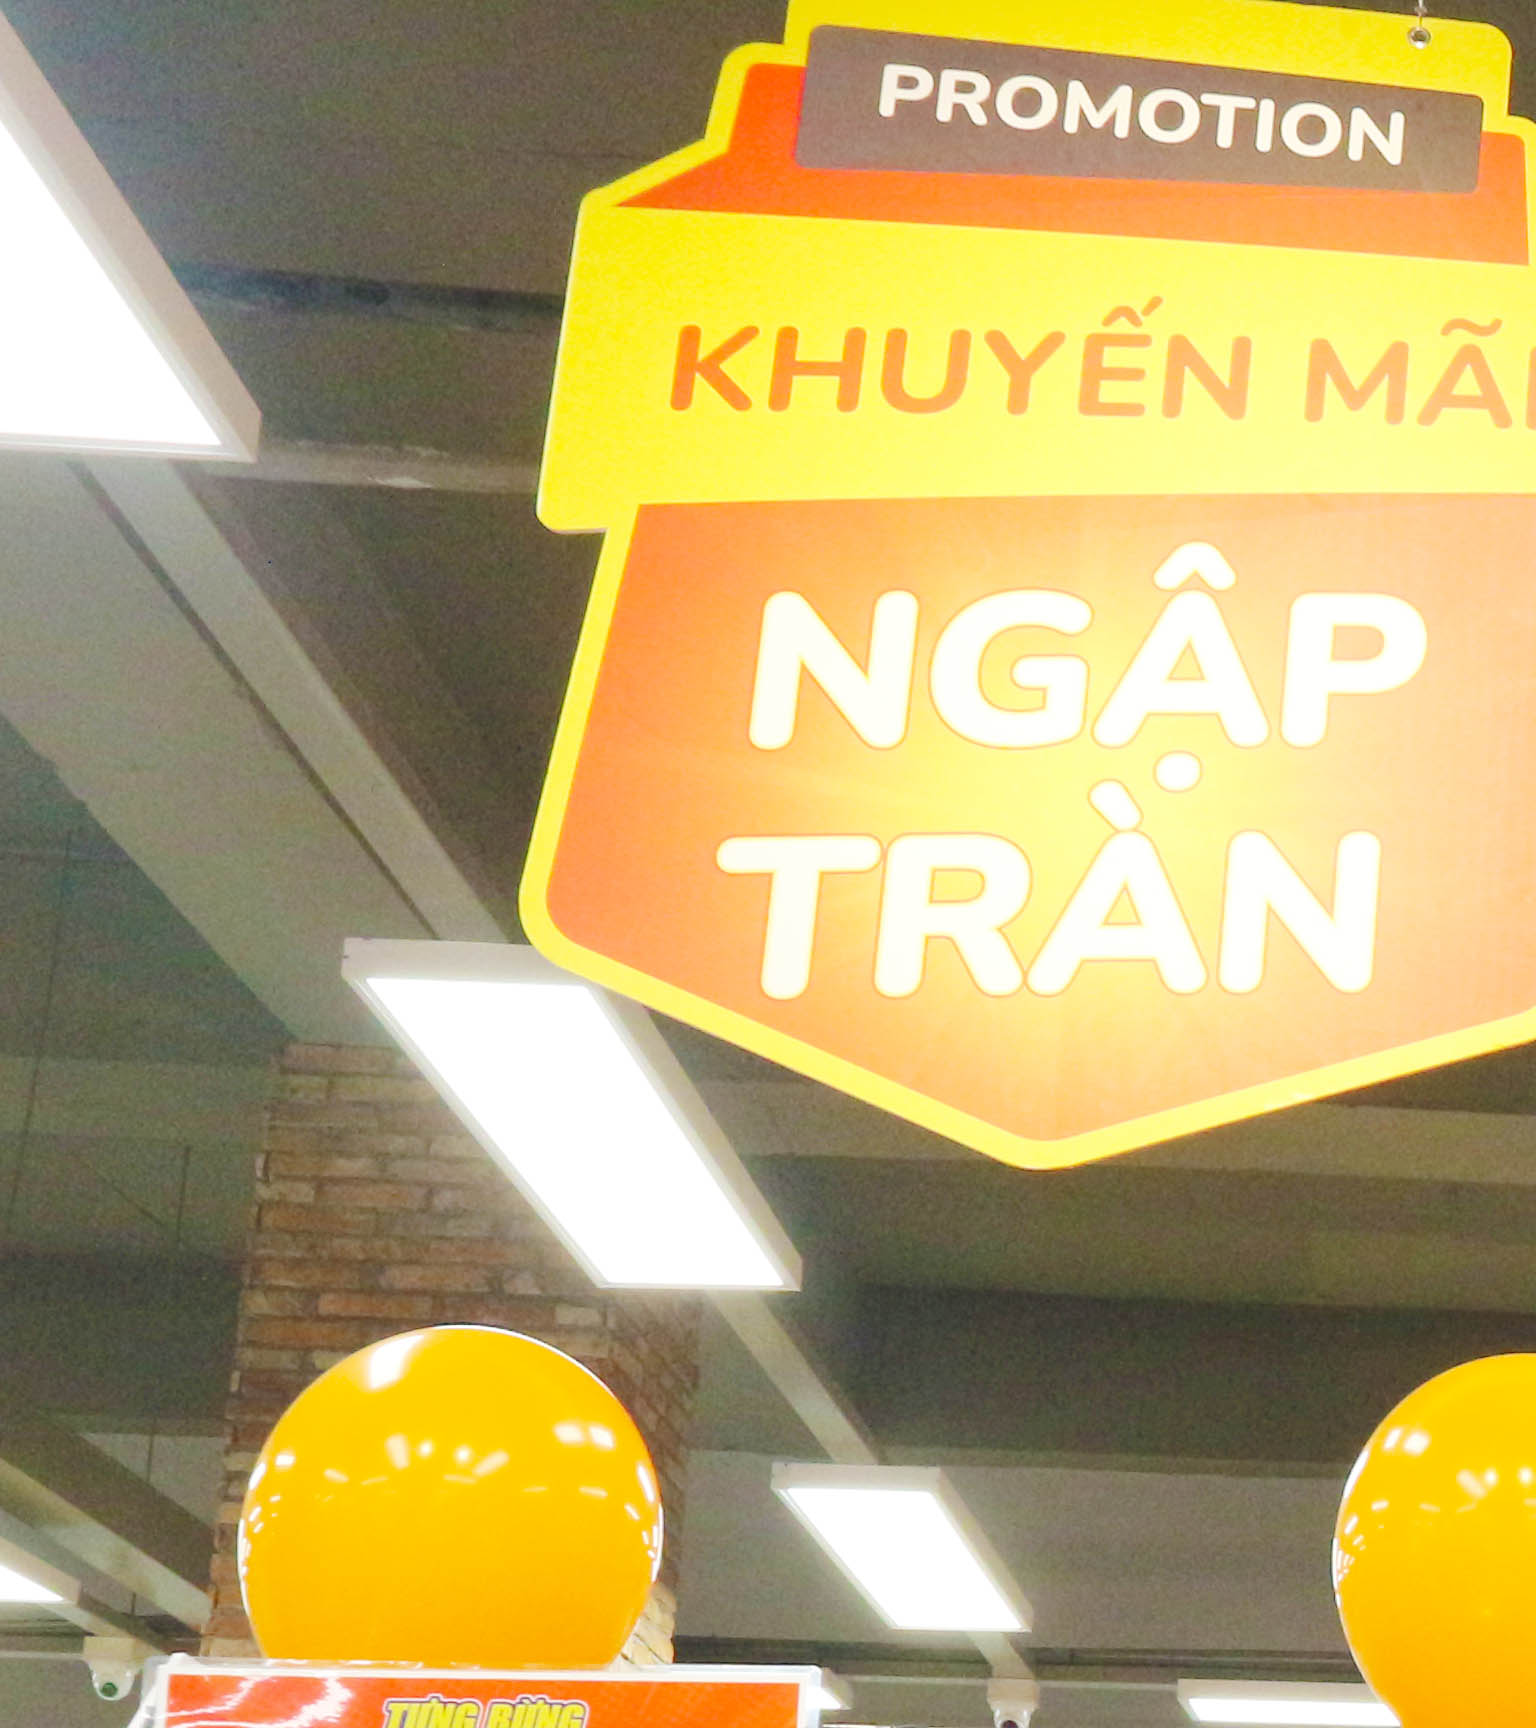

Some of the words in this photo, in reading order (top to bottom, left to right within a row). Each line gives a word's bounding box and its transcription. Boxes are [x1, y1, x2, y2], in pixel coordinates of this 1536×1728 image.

[877, 61, 1405, 166] PROMOTION
[669, 295, 1253, 421] KHUYẾN
[747, 540, 1428, 792] NGẬP
[716, 778, 1382, 999] TRÀN
